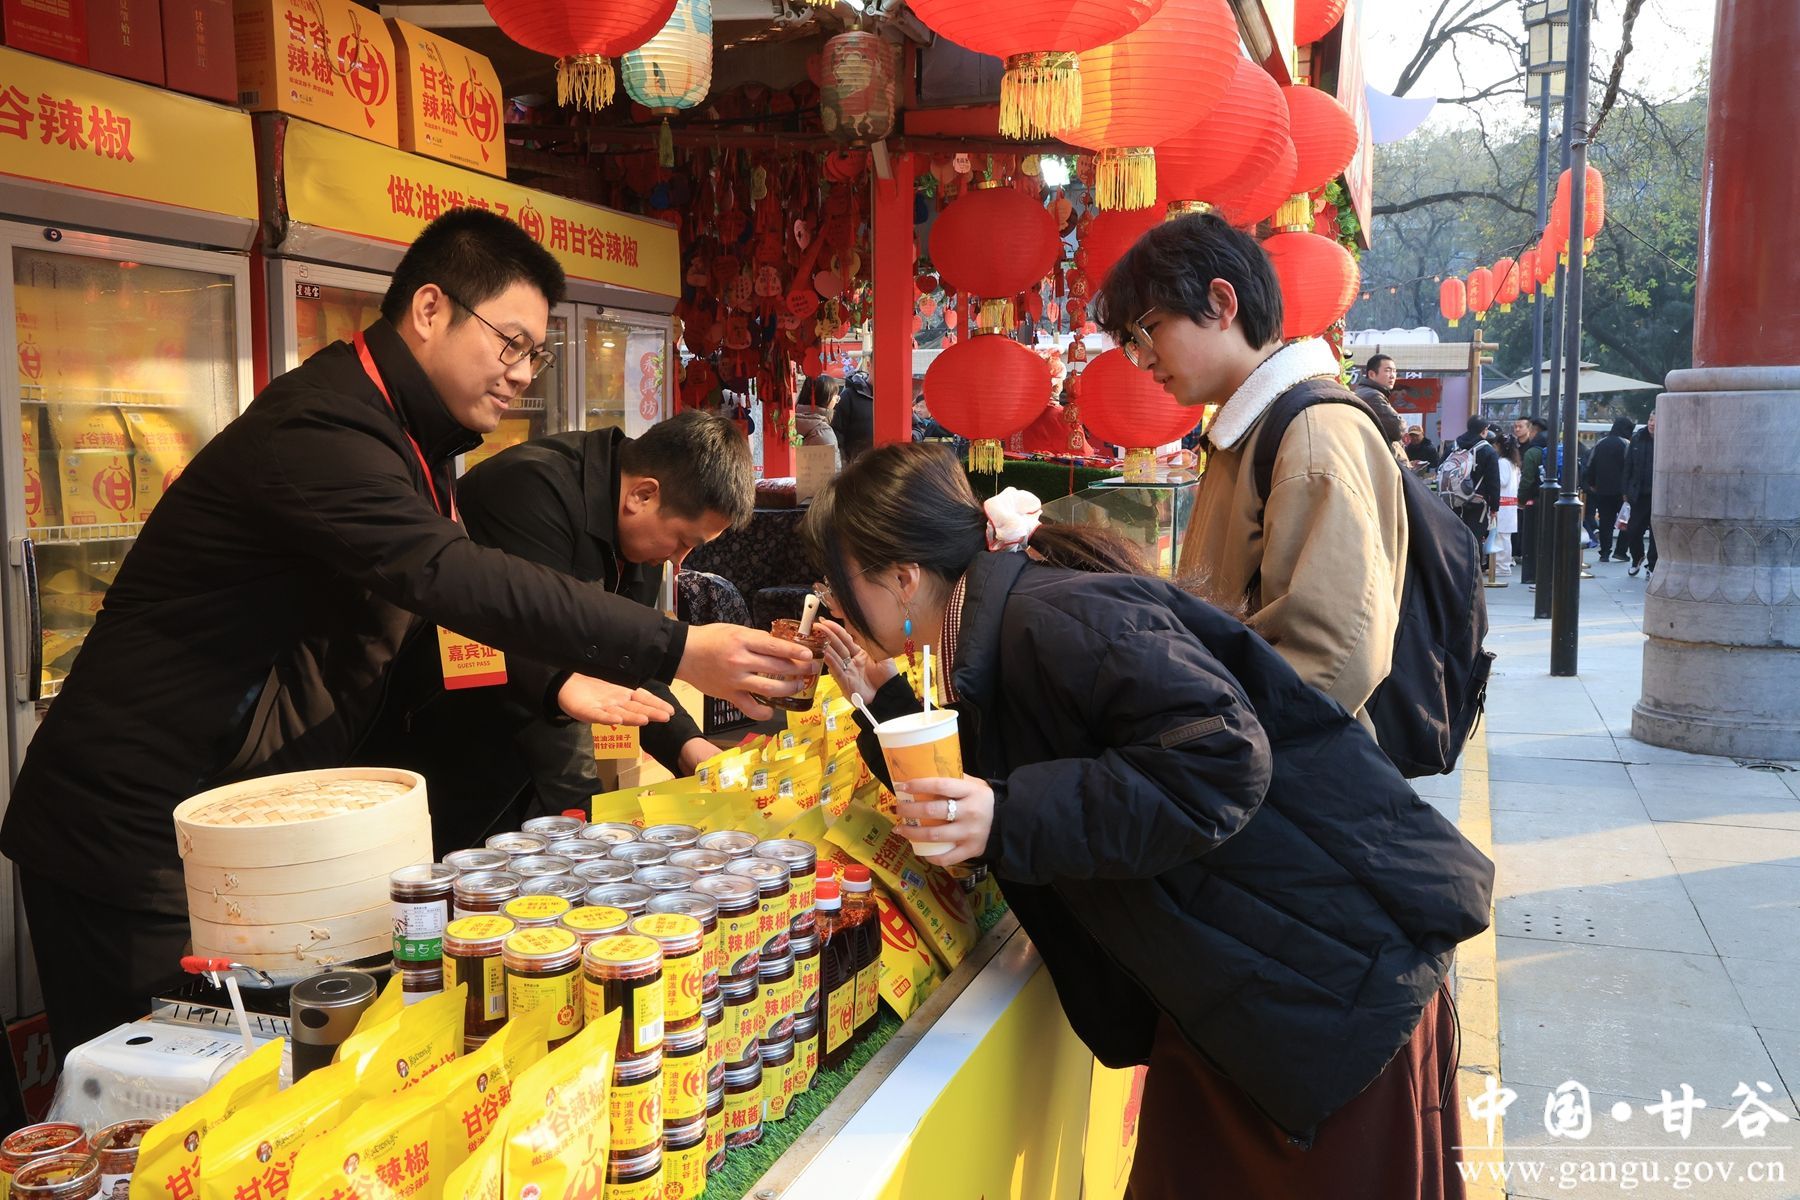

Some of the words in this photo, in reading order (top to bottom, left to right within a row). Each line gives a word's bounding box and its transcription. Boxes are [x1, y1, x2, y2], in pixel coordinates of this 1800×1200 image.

[285, 10, 331, 50] 甘谷
[288, 44, 334, 86] 辣椒
[420, 62, 455, 96] 甘谷
[423, 92, 457, 127] 辣椒
[550, 215, 639, 268] 用甘谷辣椒
[448, 643, 497, 662] 嘉宾证
[476, 660, 491, 668] PASS
